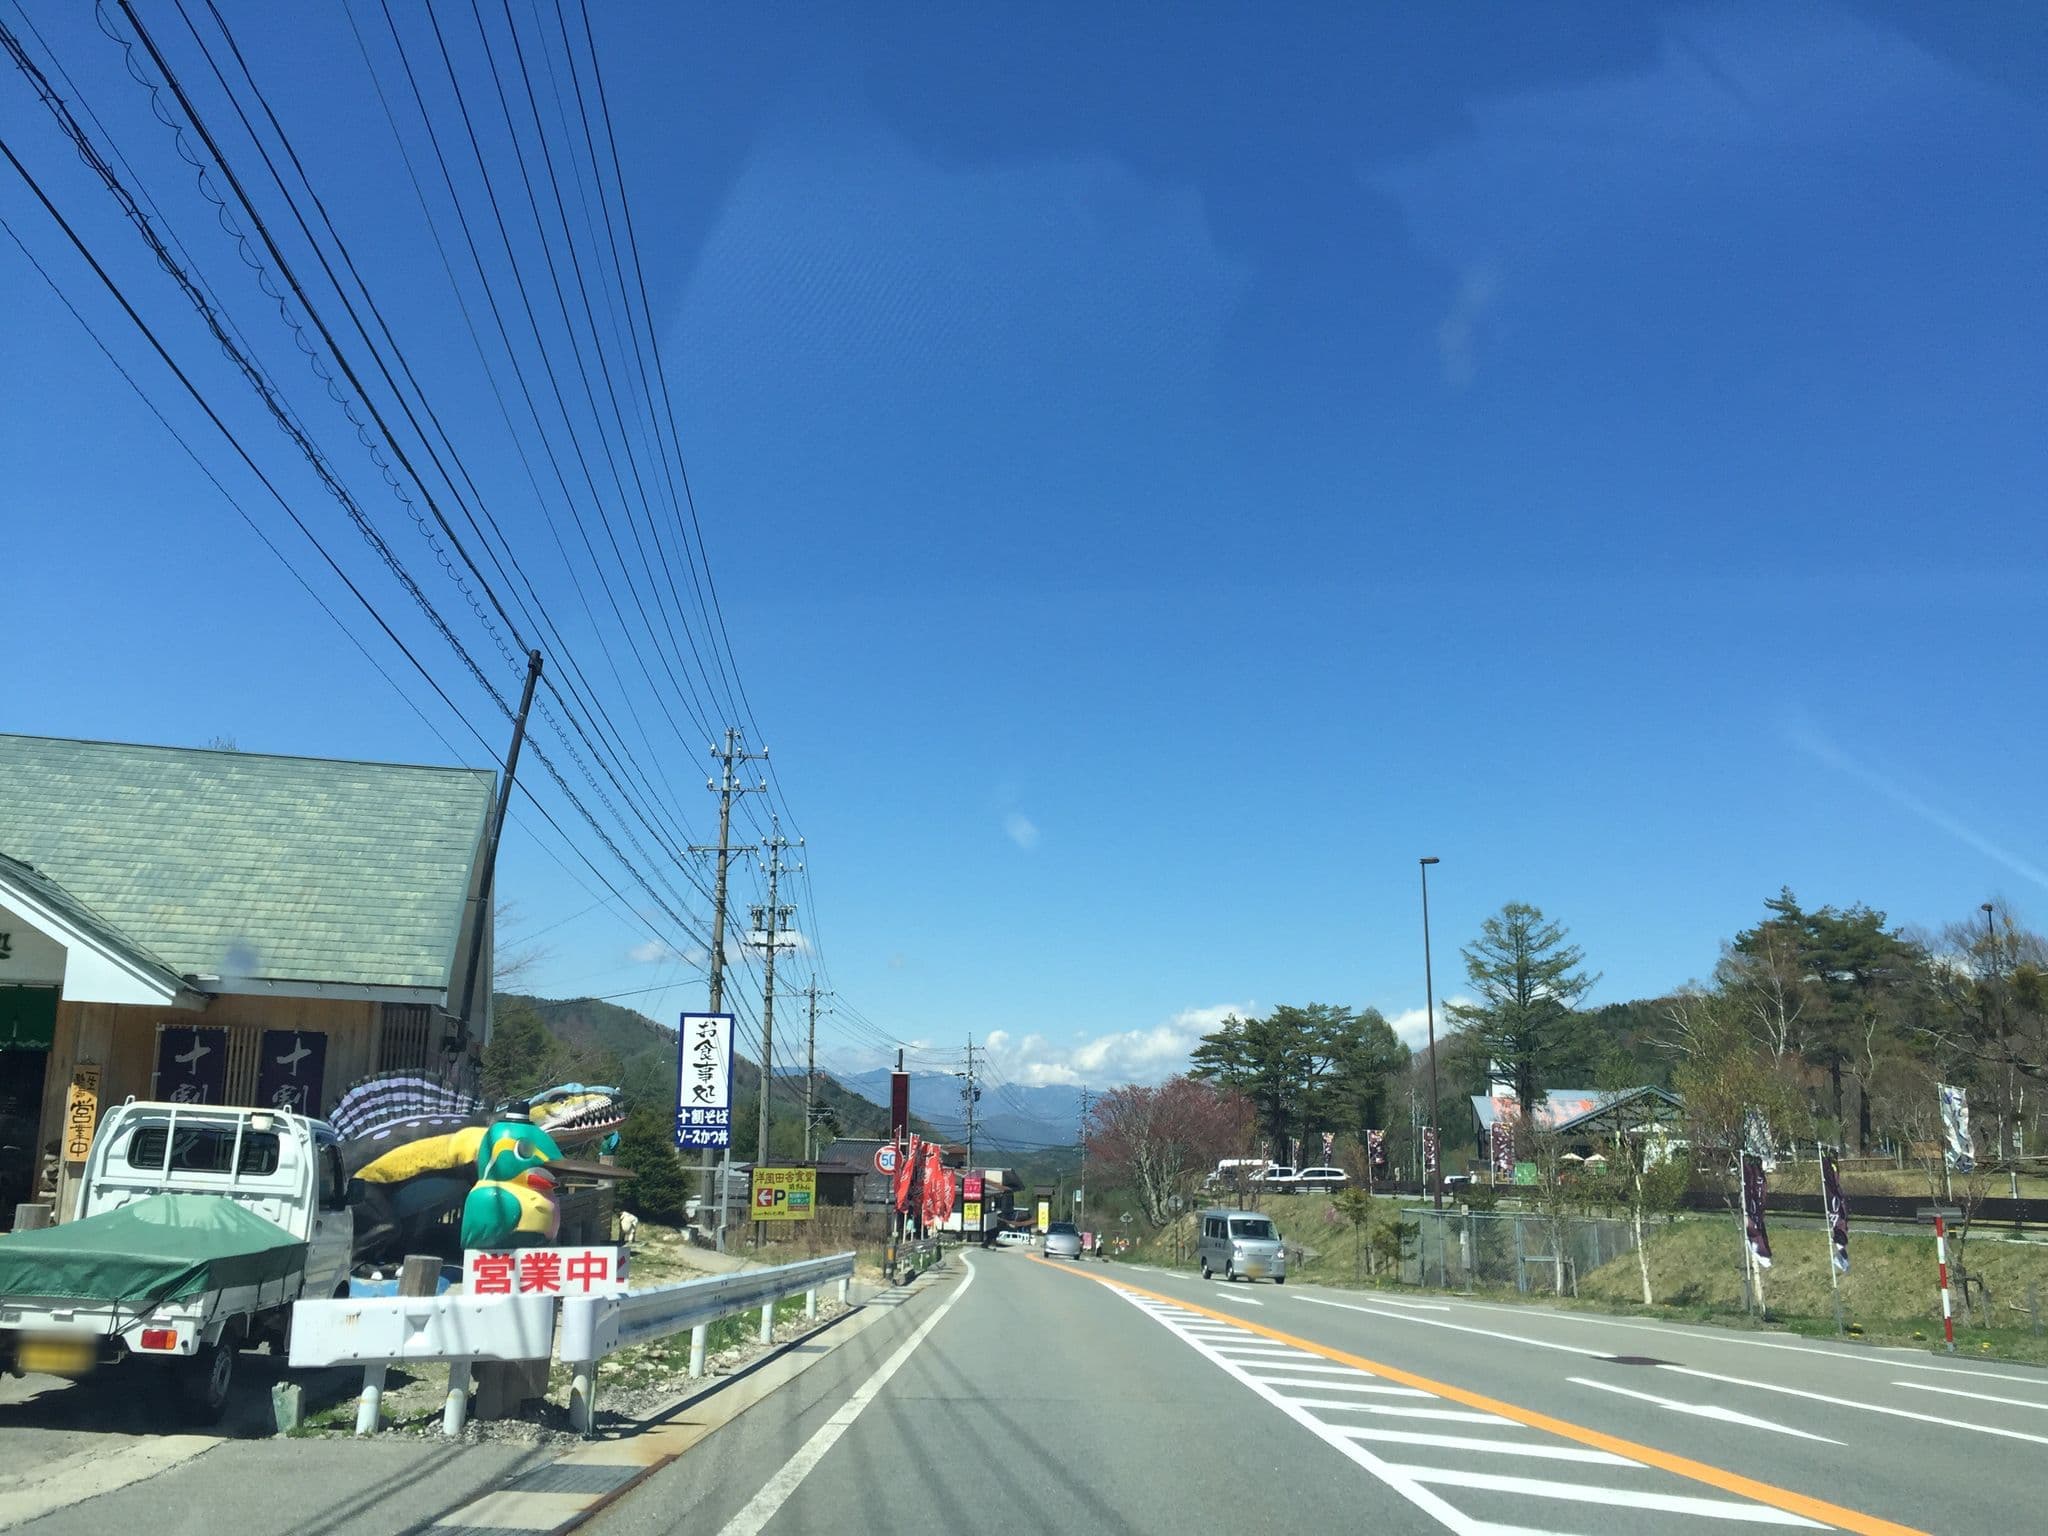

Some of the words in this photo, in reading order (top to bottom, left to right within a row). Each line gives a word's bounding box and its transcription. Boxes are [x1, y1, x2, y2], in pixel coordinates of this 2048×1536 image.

[692, 1020, 718, 1104] お食事処
[678, 1109, 729, 1125] 十割そば
[68, 1098, 94, 1157] 営業中
[677, 1129, 729, 1145] ソースかつ丼
[881, 1153, 896, 1167] 50
[774, 1189, 786, 1206] P
[472, 1251, 608, 1294] 営業中
